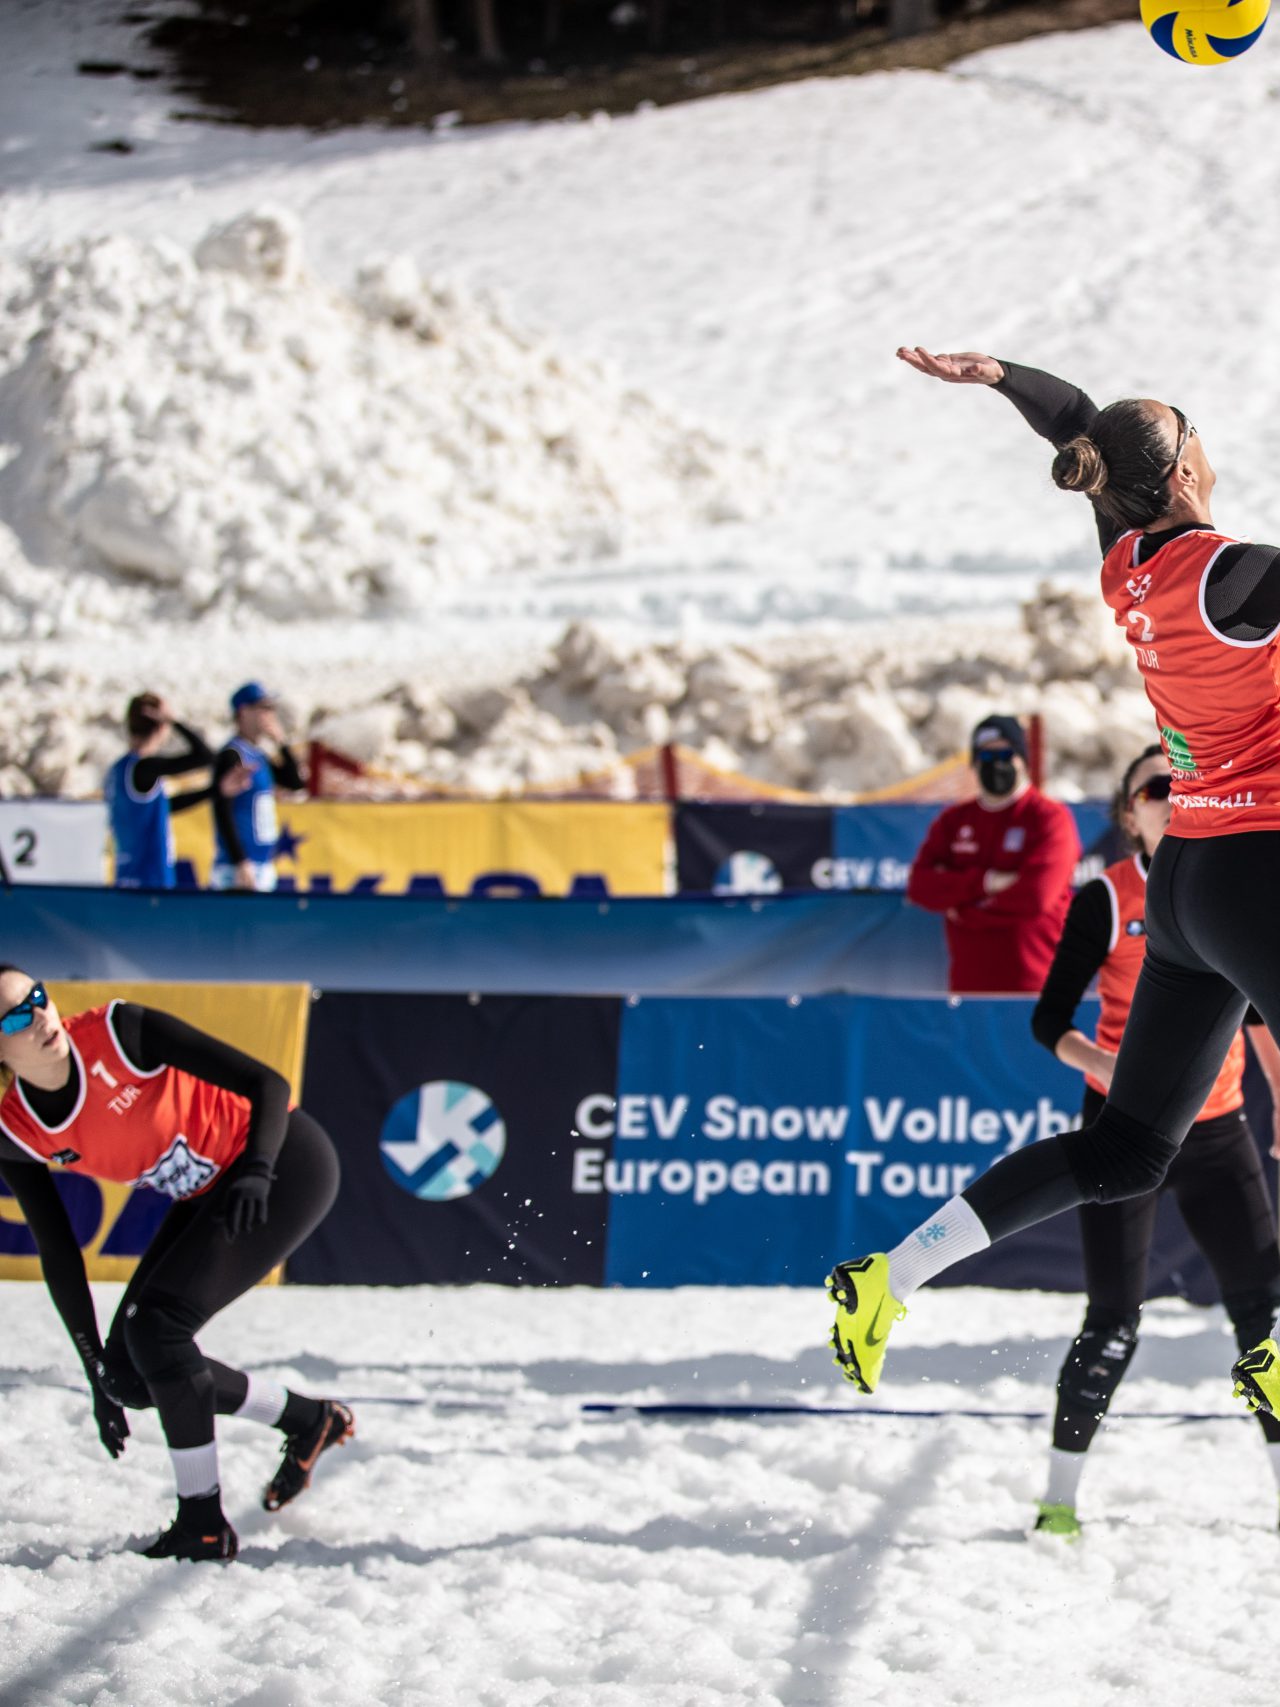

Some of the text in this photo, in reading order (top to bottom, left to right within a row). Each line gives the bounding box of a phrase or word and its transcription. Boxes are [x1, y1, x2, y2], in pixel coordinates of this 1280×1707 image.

[1127, 610, 1155, 642] 2
[1135, 647, 1160, 670] TUR
[13, 829, 37, 866] 2
[91, 1059, 119, 1089] 1
[107, 1084, 142, 1116] TUR
[574, 1094, 1082, 1153] CEV Snow Volleyb
[571, 1148, 975, 1204] European Tour
